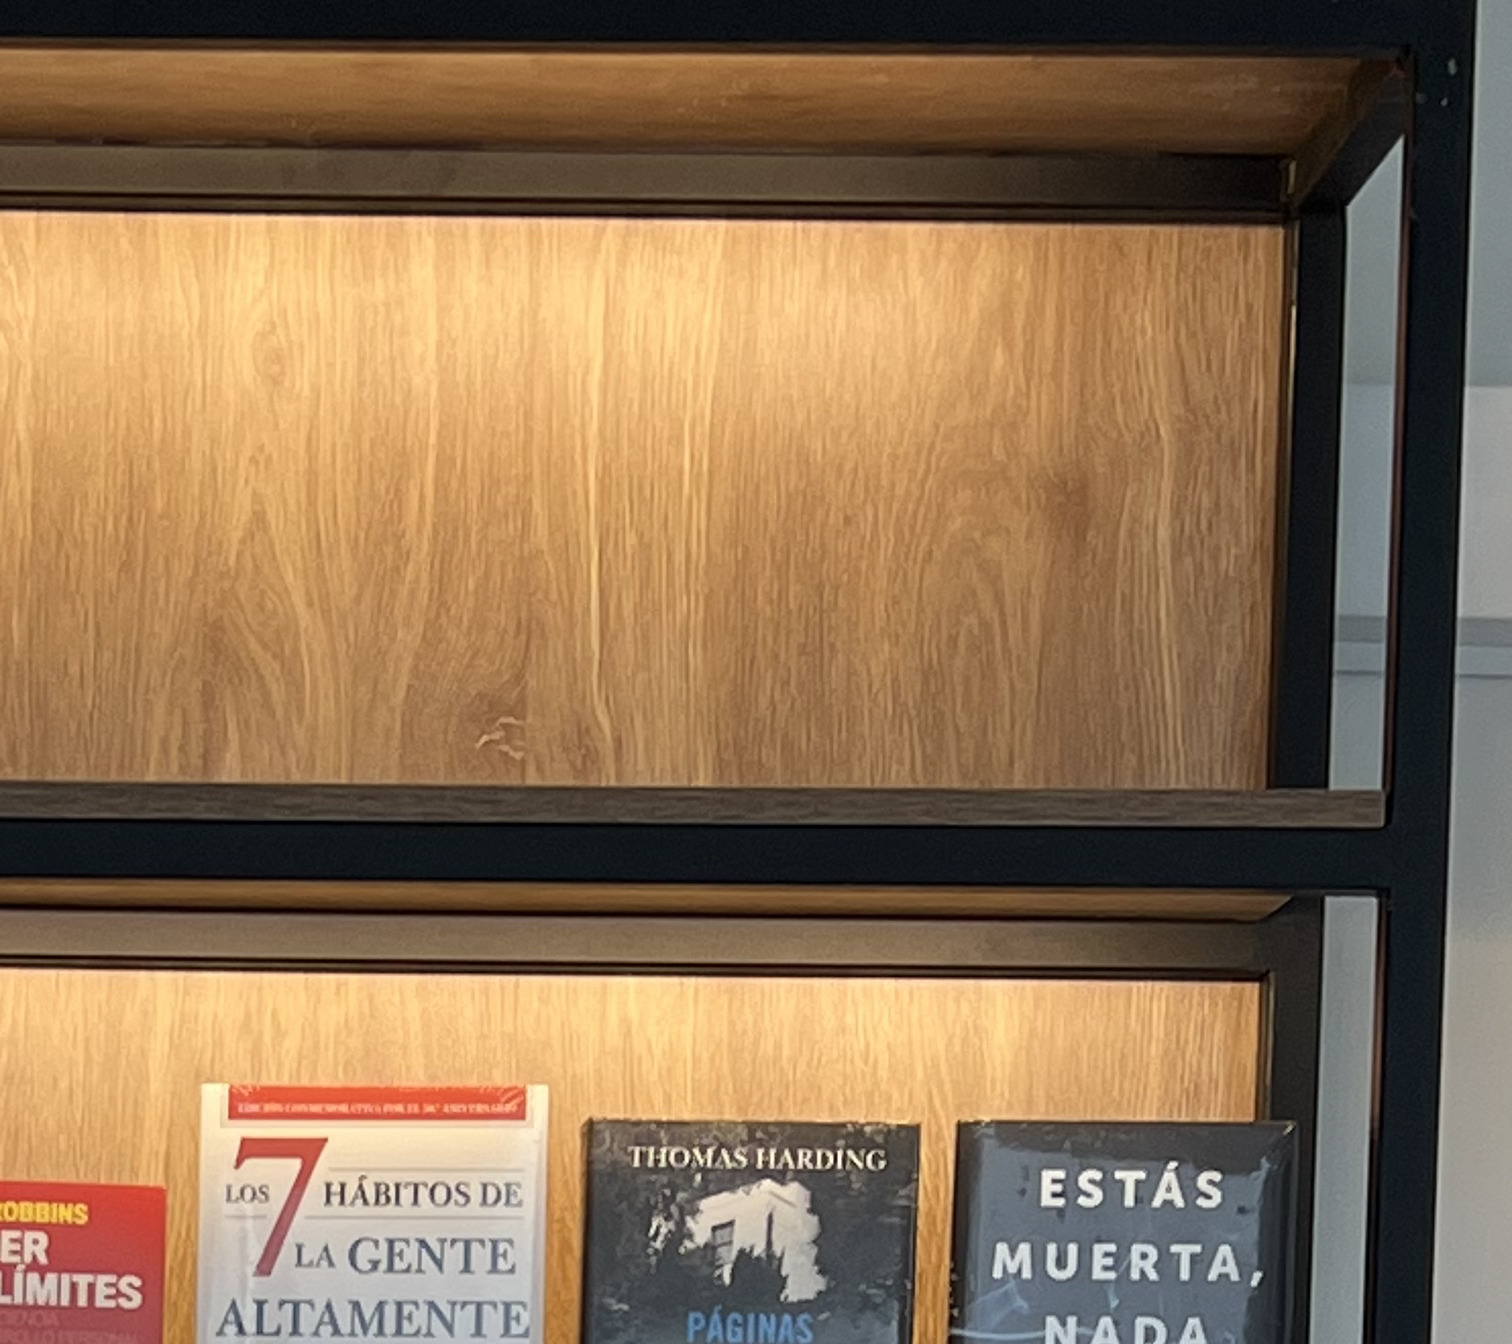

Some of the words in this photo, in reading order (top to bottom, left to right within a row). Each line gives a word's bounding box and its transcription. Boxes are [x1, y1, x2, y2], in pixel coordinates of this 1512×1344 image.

[628, 1145, 749, 1170] THOMAS
[755, 1147, 887, 1171] HARDING
[225, 1184, 270, 1204] LOS
[324, 1175, 472, 1208] HÁBITOS
[478, 1182, 524, 1208] DE
[1040, 1161, 1224, 1209] ESTÁS
[233, 1137, 329, 1278] 7
[295, 1244, 336, 1269] LA
[347, 1237, 517, 1275] GENTE
[992, 1242, 1264, 1287] MUERTA,
[215, 1299, 531, 1340] ALTAMENTE
[687, 1305, 814, 1344] PÁGINAS
